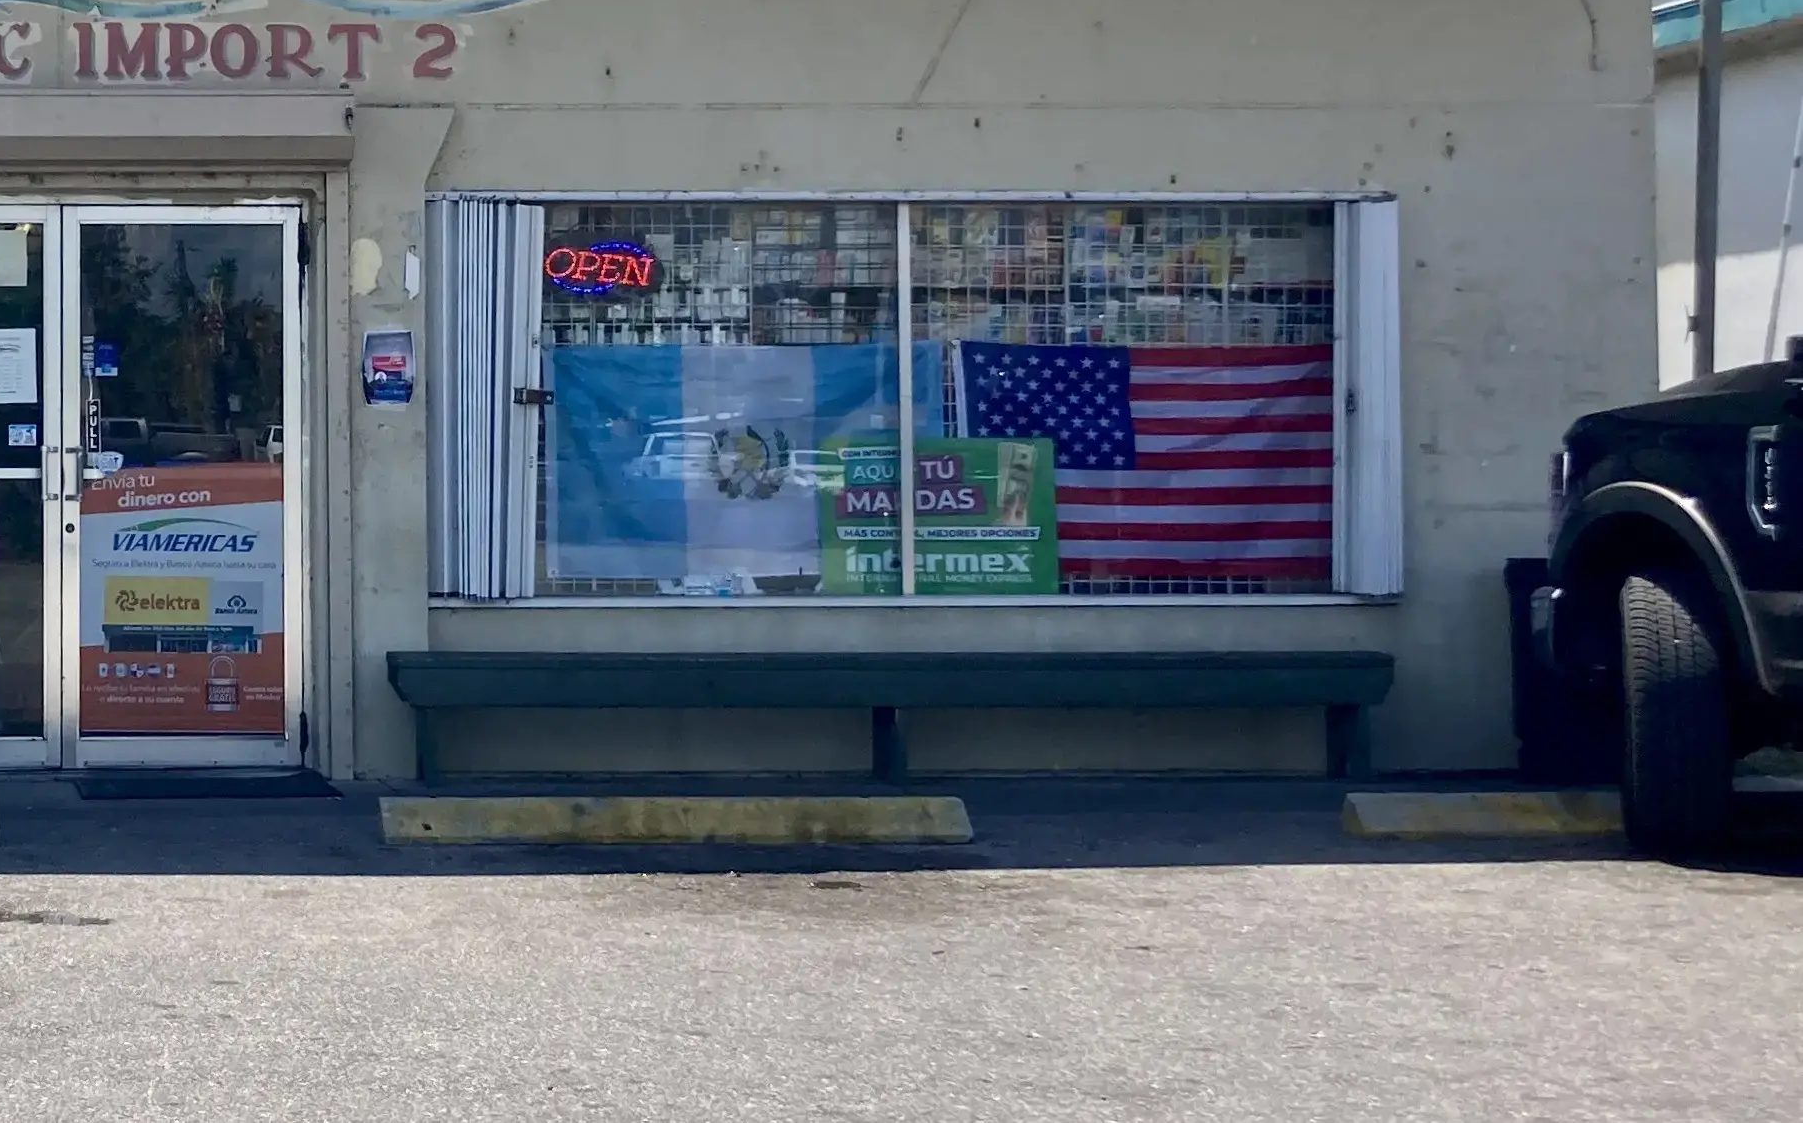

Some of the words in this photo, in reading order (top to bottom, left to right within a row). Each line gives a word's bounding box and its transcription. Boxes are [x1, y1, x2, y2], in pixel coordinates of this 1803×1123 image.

[72, 20, 383, 80] IMPORT
[412, 22, 458, 79] 2
[545, 246, 654, 287] OPEN
[89, 404, 97, 449] PULL
[862, 448, 901, 457] INTERM
[852, 464, 895, 482] AQU
[919, 454, 955, 480] TÚ
[139, 473, 156, 488] tu
[117, 490, 175, 508] dinero
[178, 488, 211, 504] con
[846, 487, 976, 512] MADAS
[111, 533, 258, 553] VIAMERICAS
[139, 593, 200, 611] elektra
